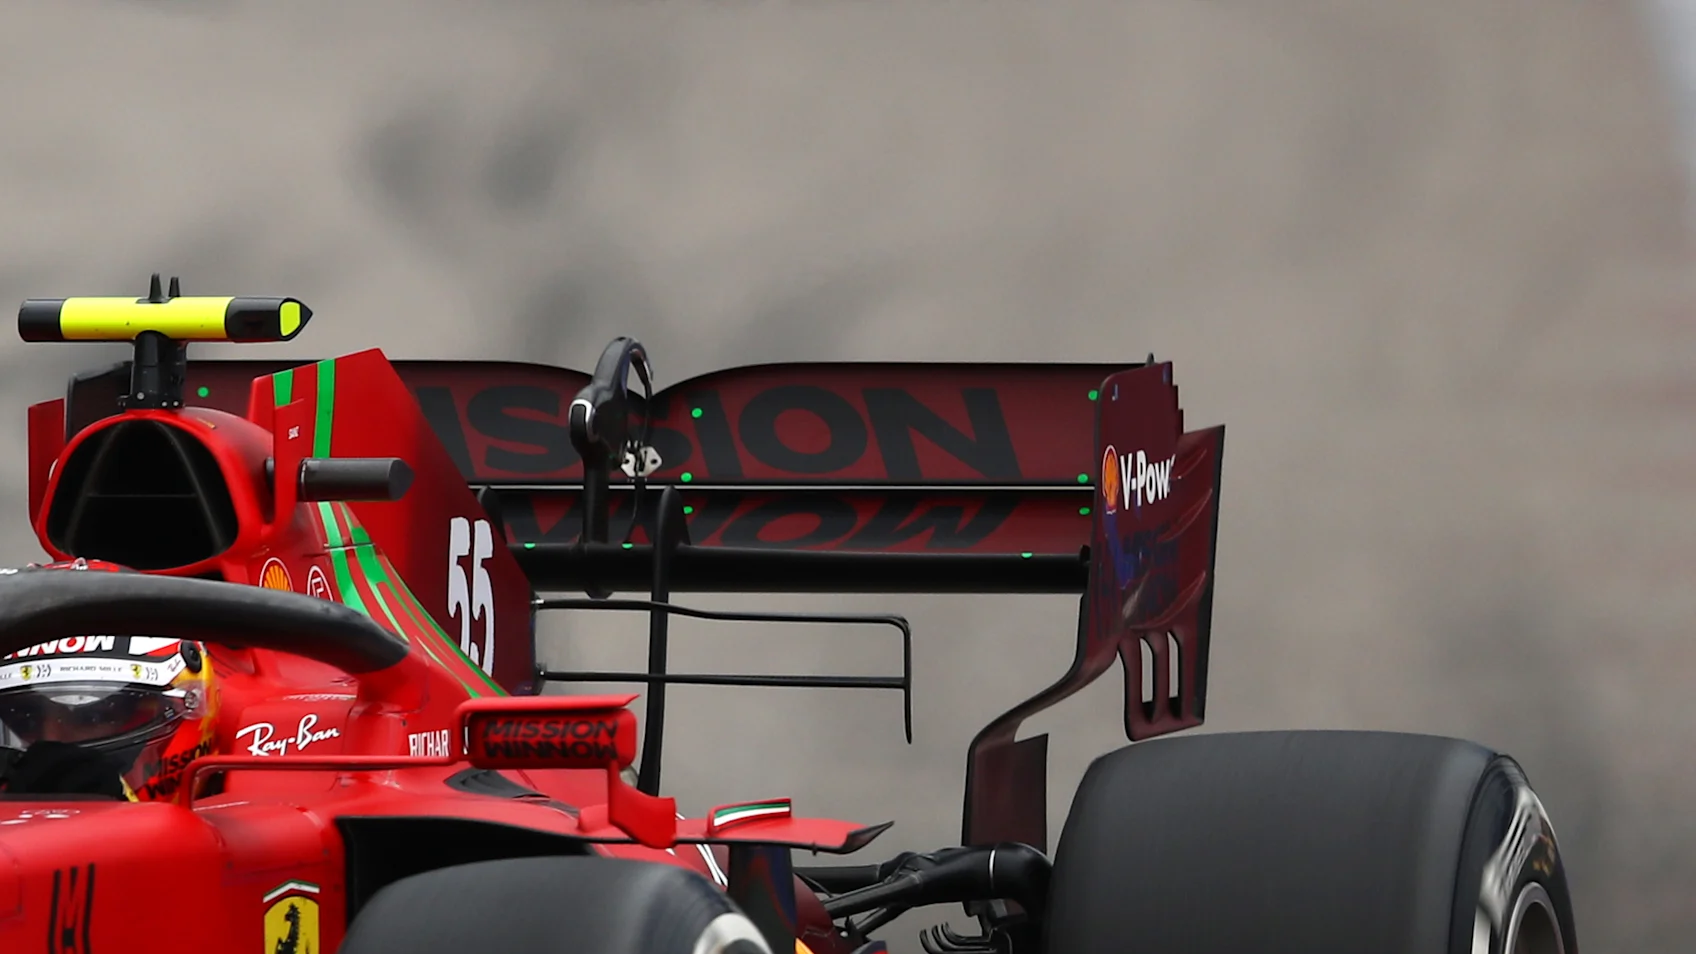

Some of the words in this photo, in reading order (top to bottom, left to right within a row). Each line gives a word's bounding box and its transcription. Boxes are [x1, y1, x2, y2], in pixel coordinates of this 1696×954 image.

[417, 385, 1023, 478] ISSION
[1120, 450, 1175, 510] V-Pow
[448, 517, 495, 677] 55
[236, 714, 340, 756] Ray-Ban
[408, 729, 451, 757] RICHAR
[482, 718, 619, 739] MISSION
[482, 740, 619, 760] WINNOW
